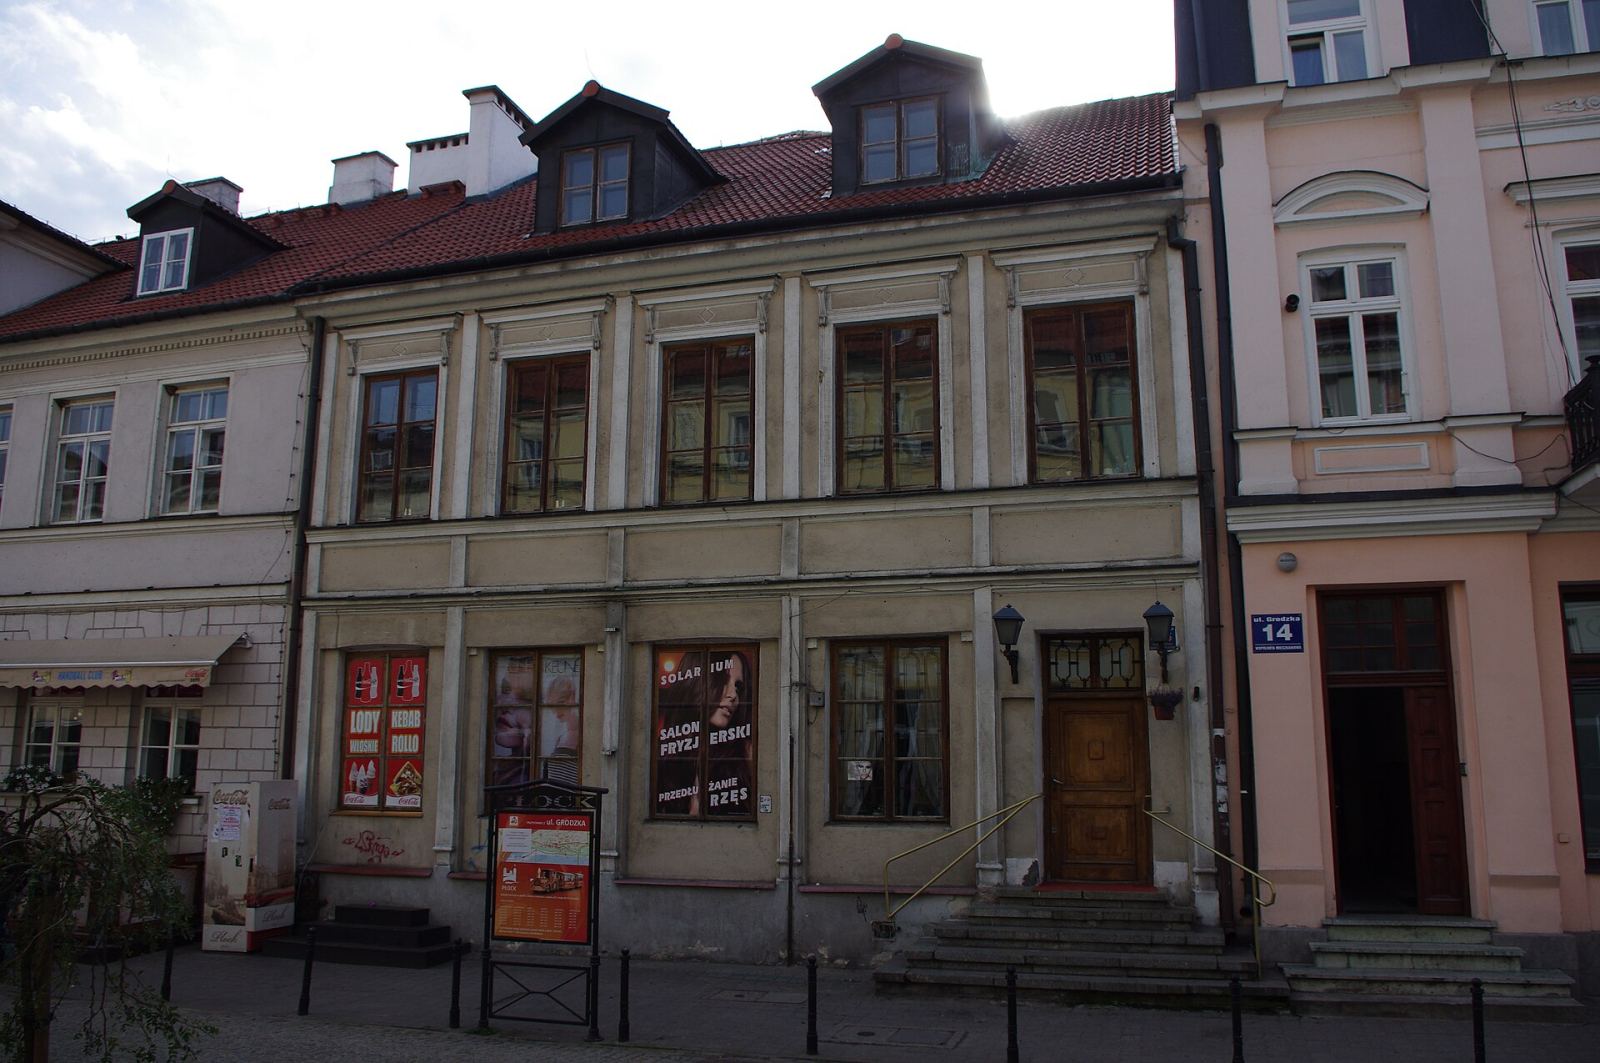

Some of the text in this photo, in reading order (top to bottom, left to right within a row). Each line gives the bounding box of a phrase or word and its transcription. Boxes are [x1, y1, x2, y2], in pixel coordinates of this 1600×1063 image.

[1262, 623, 1293, 642] 14
[350, 708, 381, 734] LODY
[391, 709, 421, 729] KEBAB
[660, 721, 700, 741] SALON
[391, 734, 419, 754] ROLLO
[555, 819, 586, 827] GRODZKA
